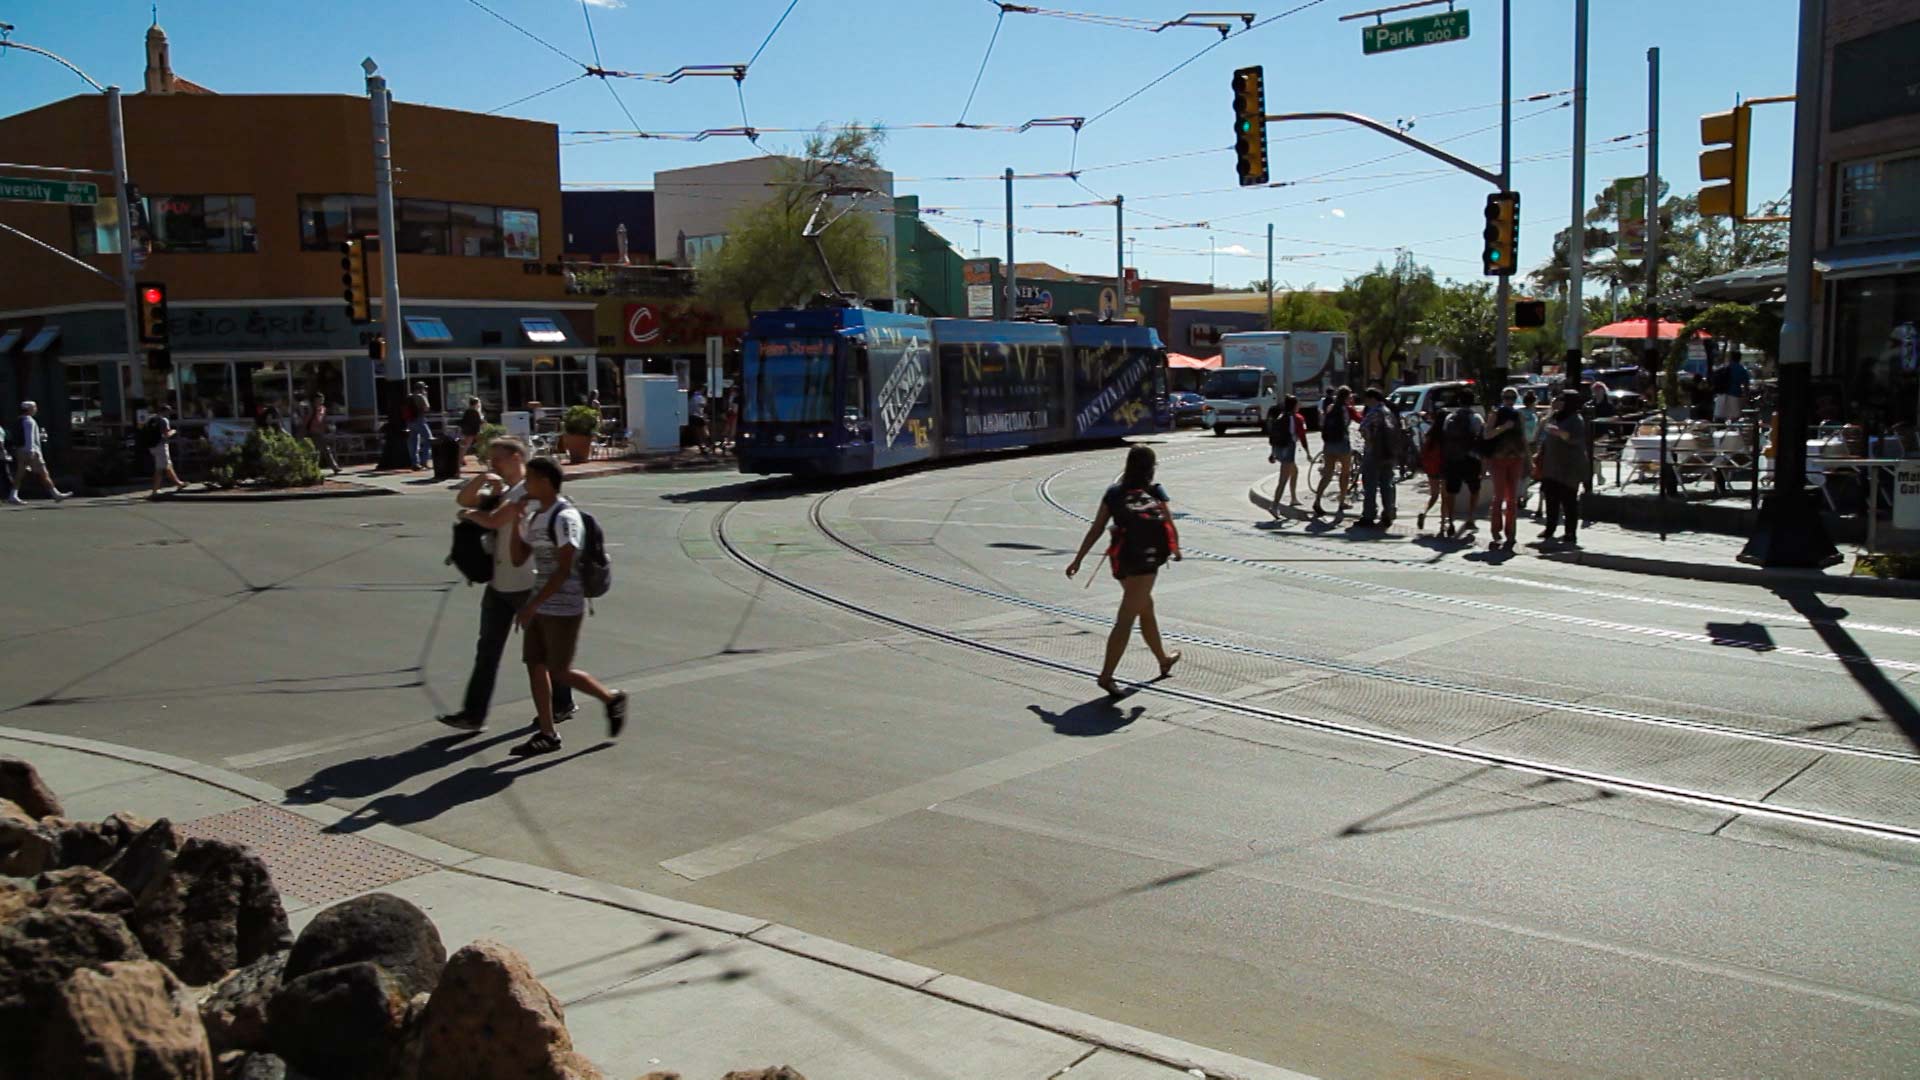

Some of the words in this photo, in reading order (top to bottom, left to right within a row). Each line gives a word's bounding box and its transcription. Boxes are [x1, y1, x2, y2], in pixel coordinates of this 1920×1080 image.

[1365, 30, 1373, 40] N
[1376, 26, 1415, 49] Park
[1433, 16, 1456, 28] Ave
[1424, 29, 1451, 42] 1000
[1459, 26, 1466, 36] E
[962, 342, 1047, 382] NVA
